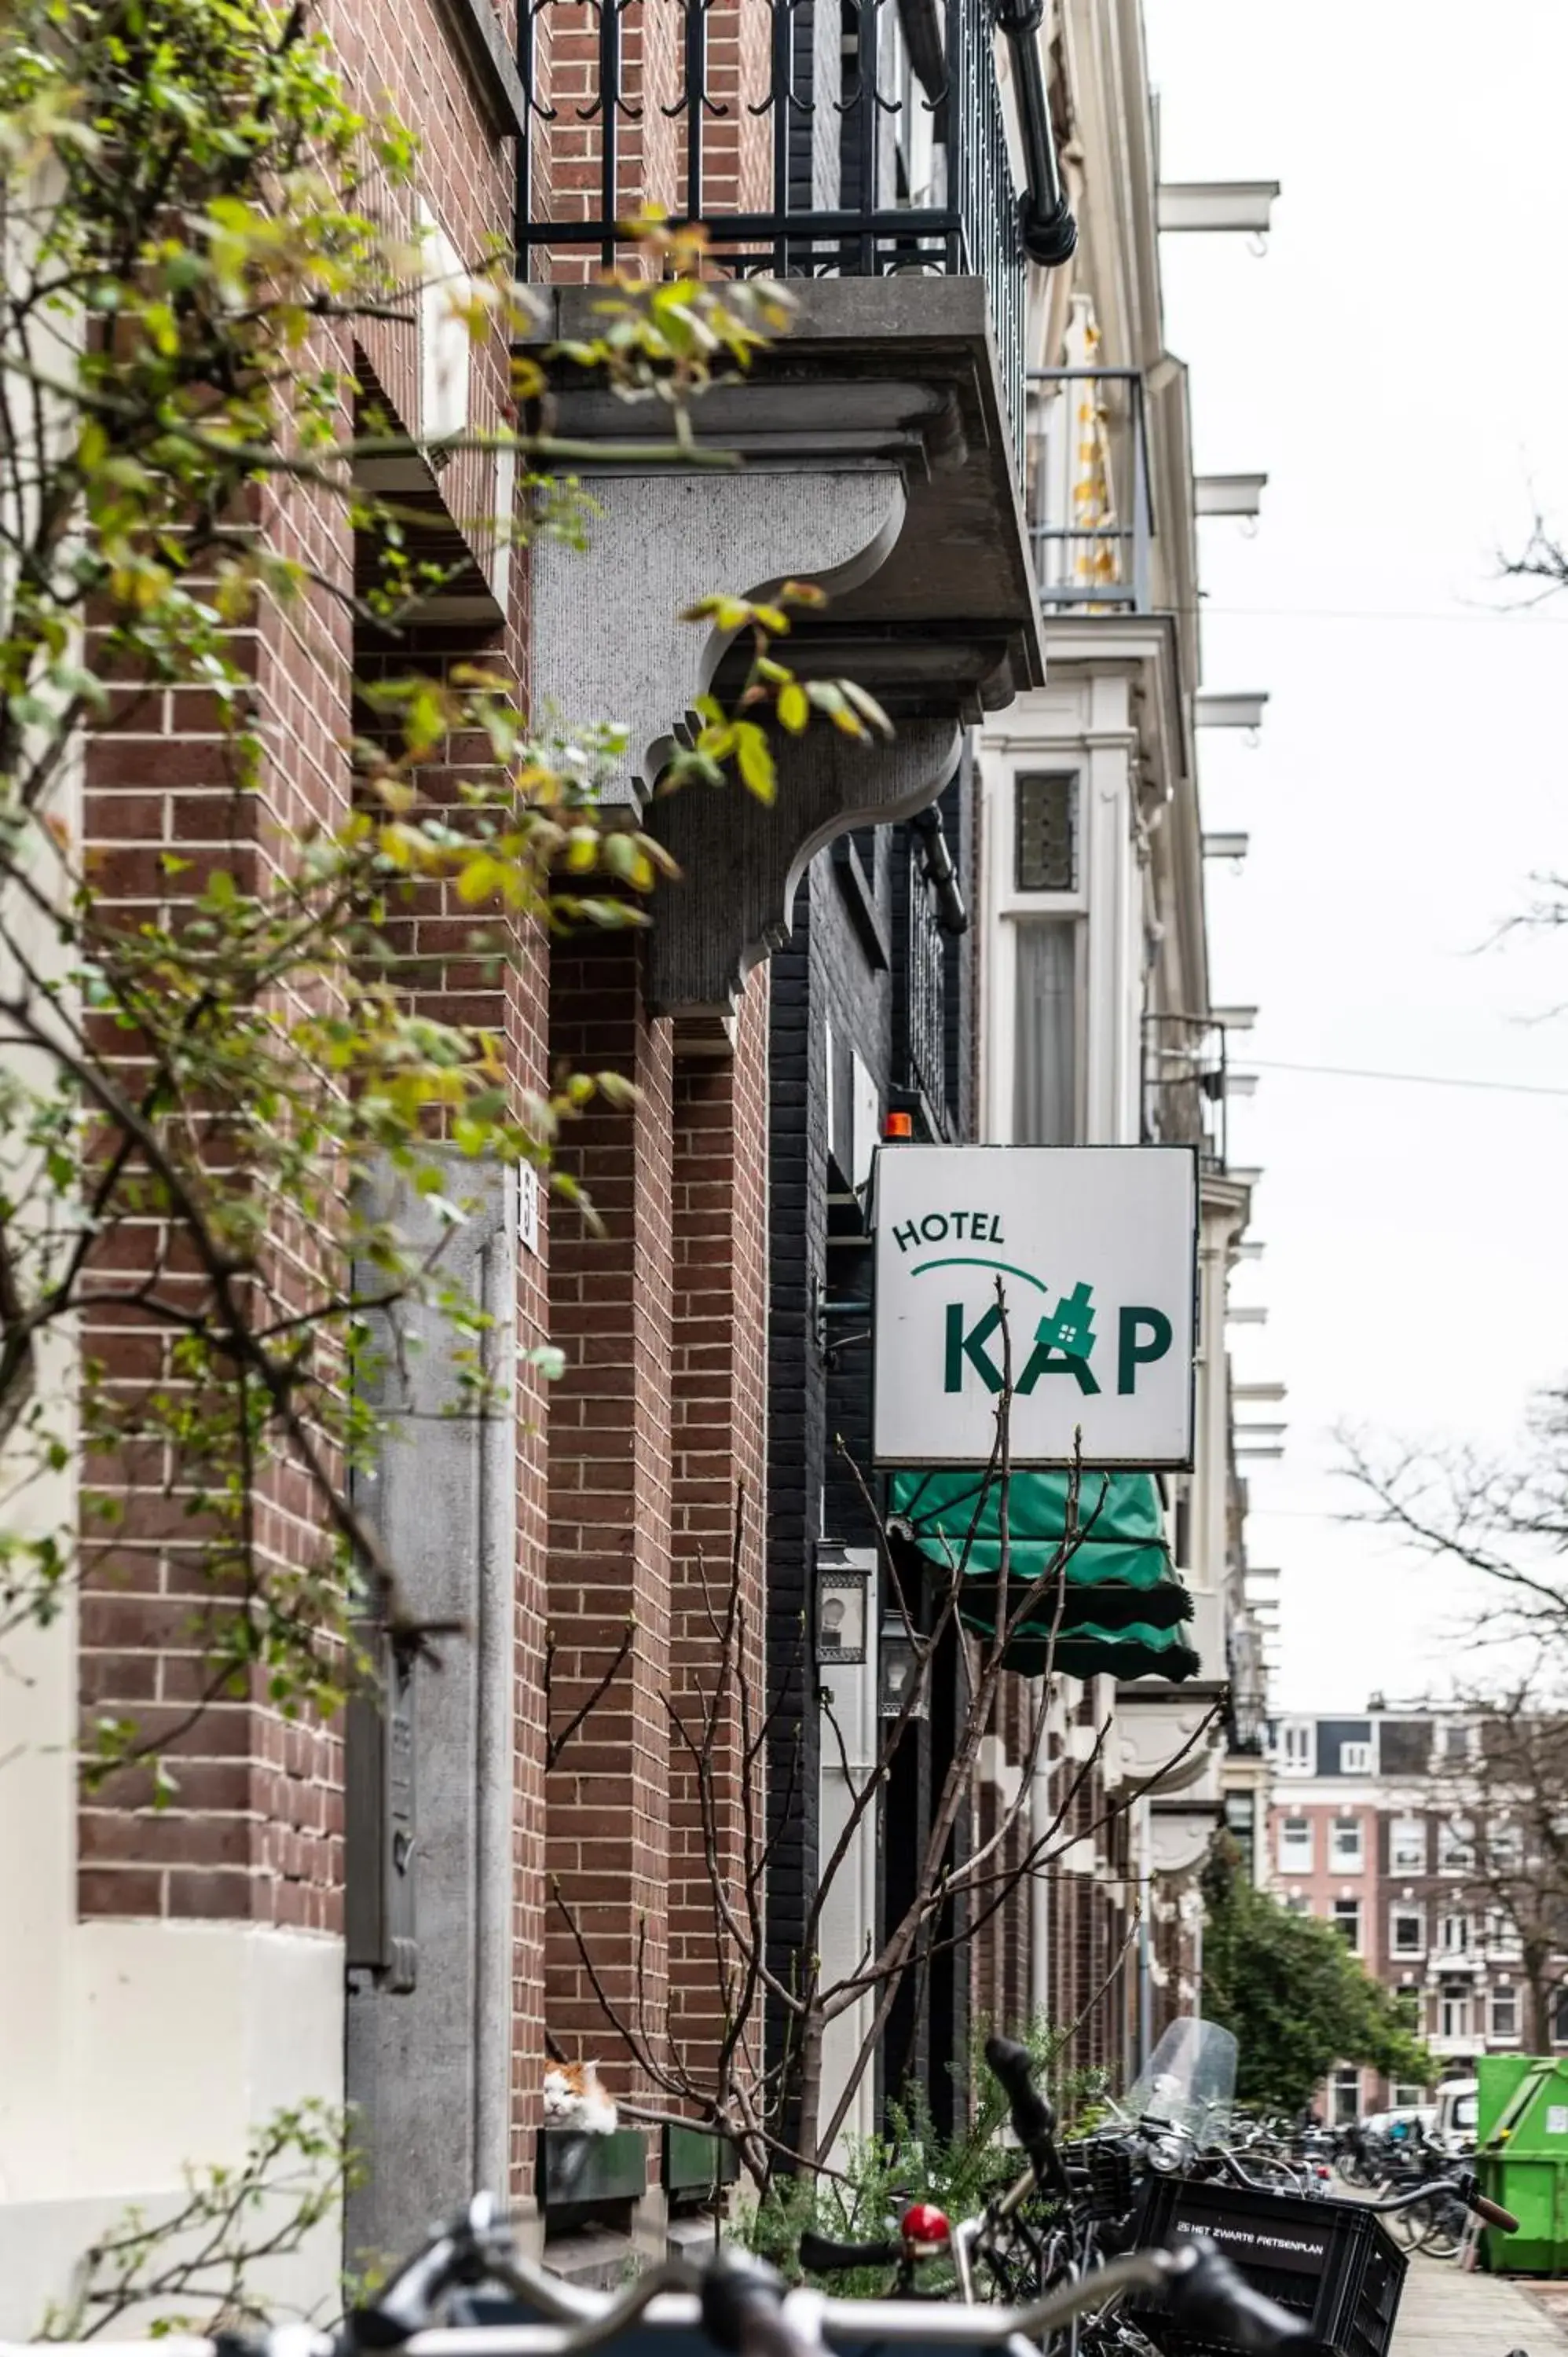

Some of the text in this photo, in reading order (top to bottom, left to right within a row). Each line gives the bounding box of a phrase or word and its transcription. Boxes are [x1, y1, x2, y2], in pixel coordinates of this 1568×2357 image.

[892, 1211, 1005, 1252] HOTEL
[944, 1282, 1173, 1395] KAP
[1191, 2224, 1211, 2235] HET
[1213, 2227, 1255, 2243] ZWARTE
